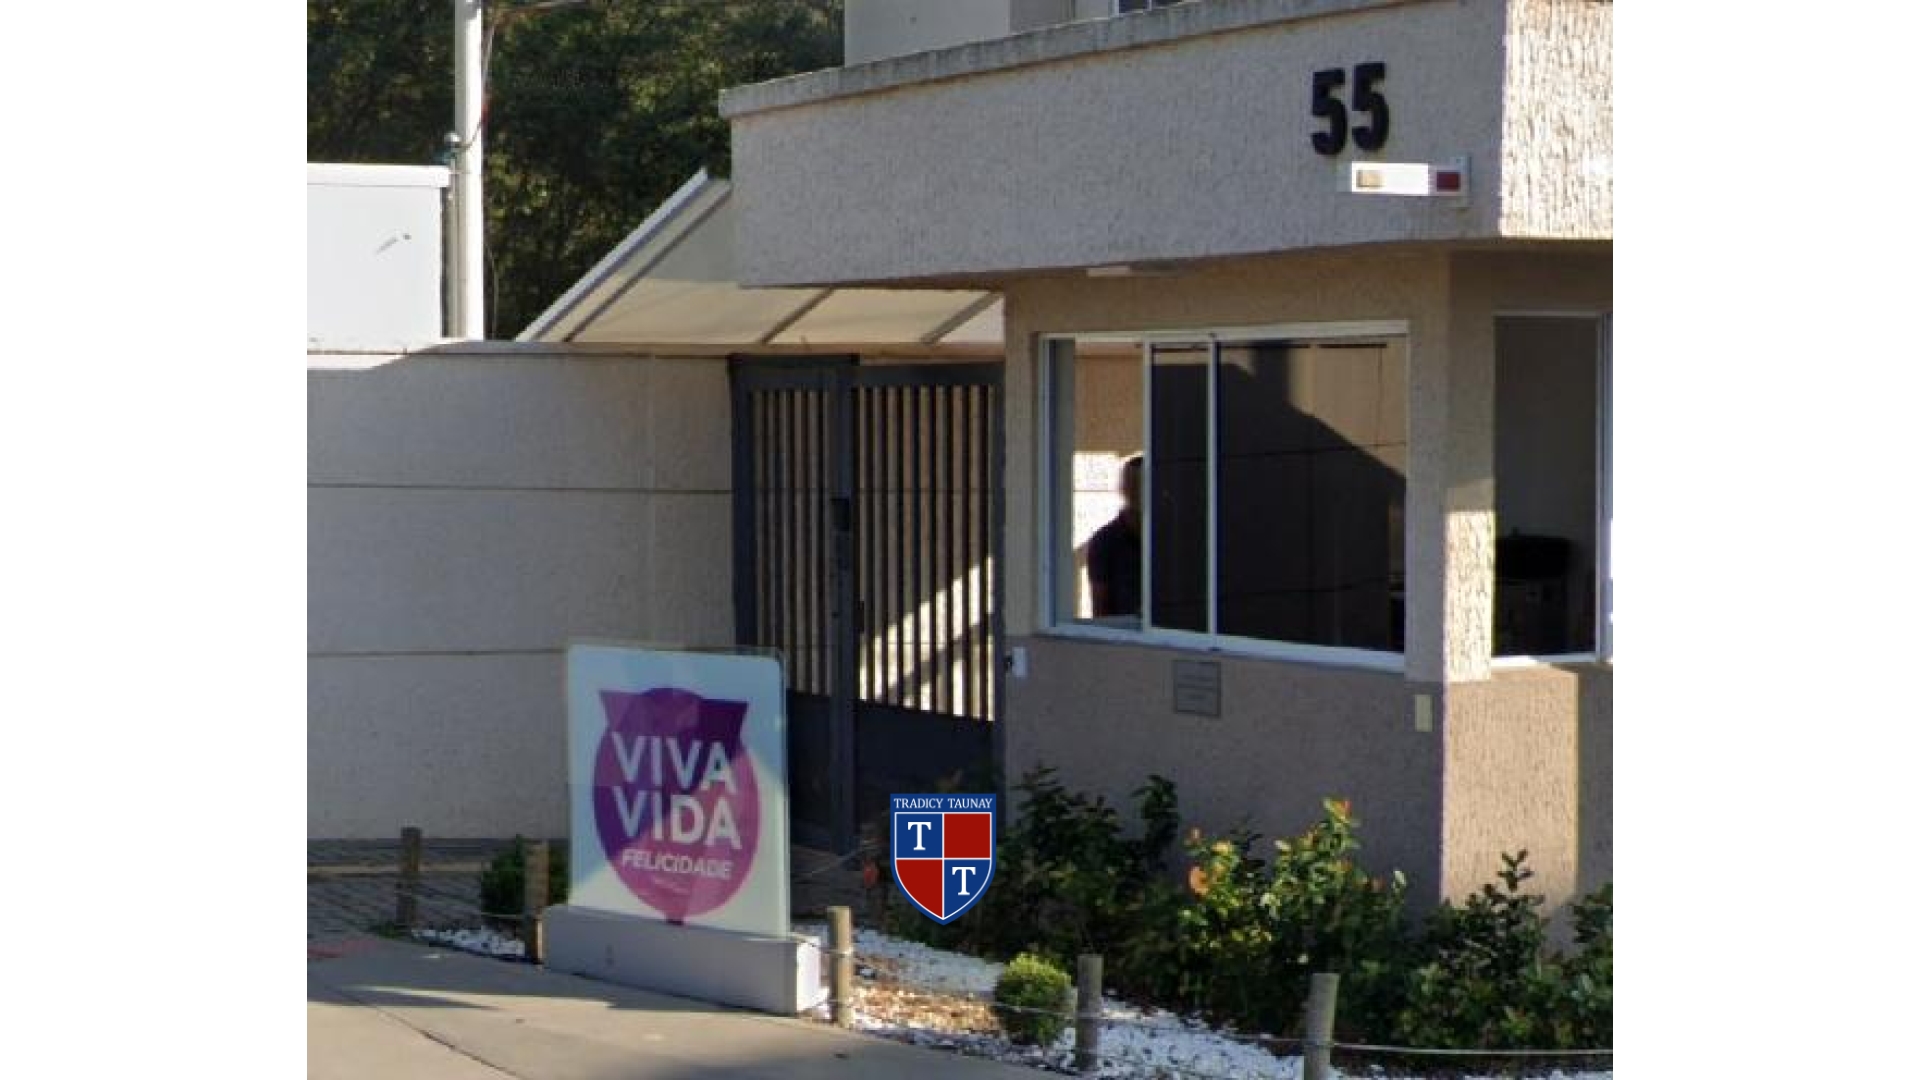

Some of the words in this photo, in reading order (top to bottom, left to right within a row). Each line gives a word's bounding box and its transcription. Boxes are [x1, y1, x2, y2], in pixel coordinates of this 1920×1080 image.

[1311, 62, 1390, 156] 55
[611, 731, 738, 795] VIVA
[611, 785, 743, 850] VIDA
[621, 849, 735, 879] FELICIDADE
